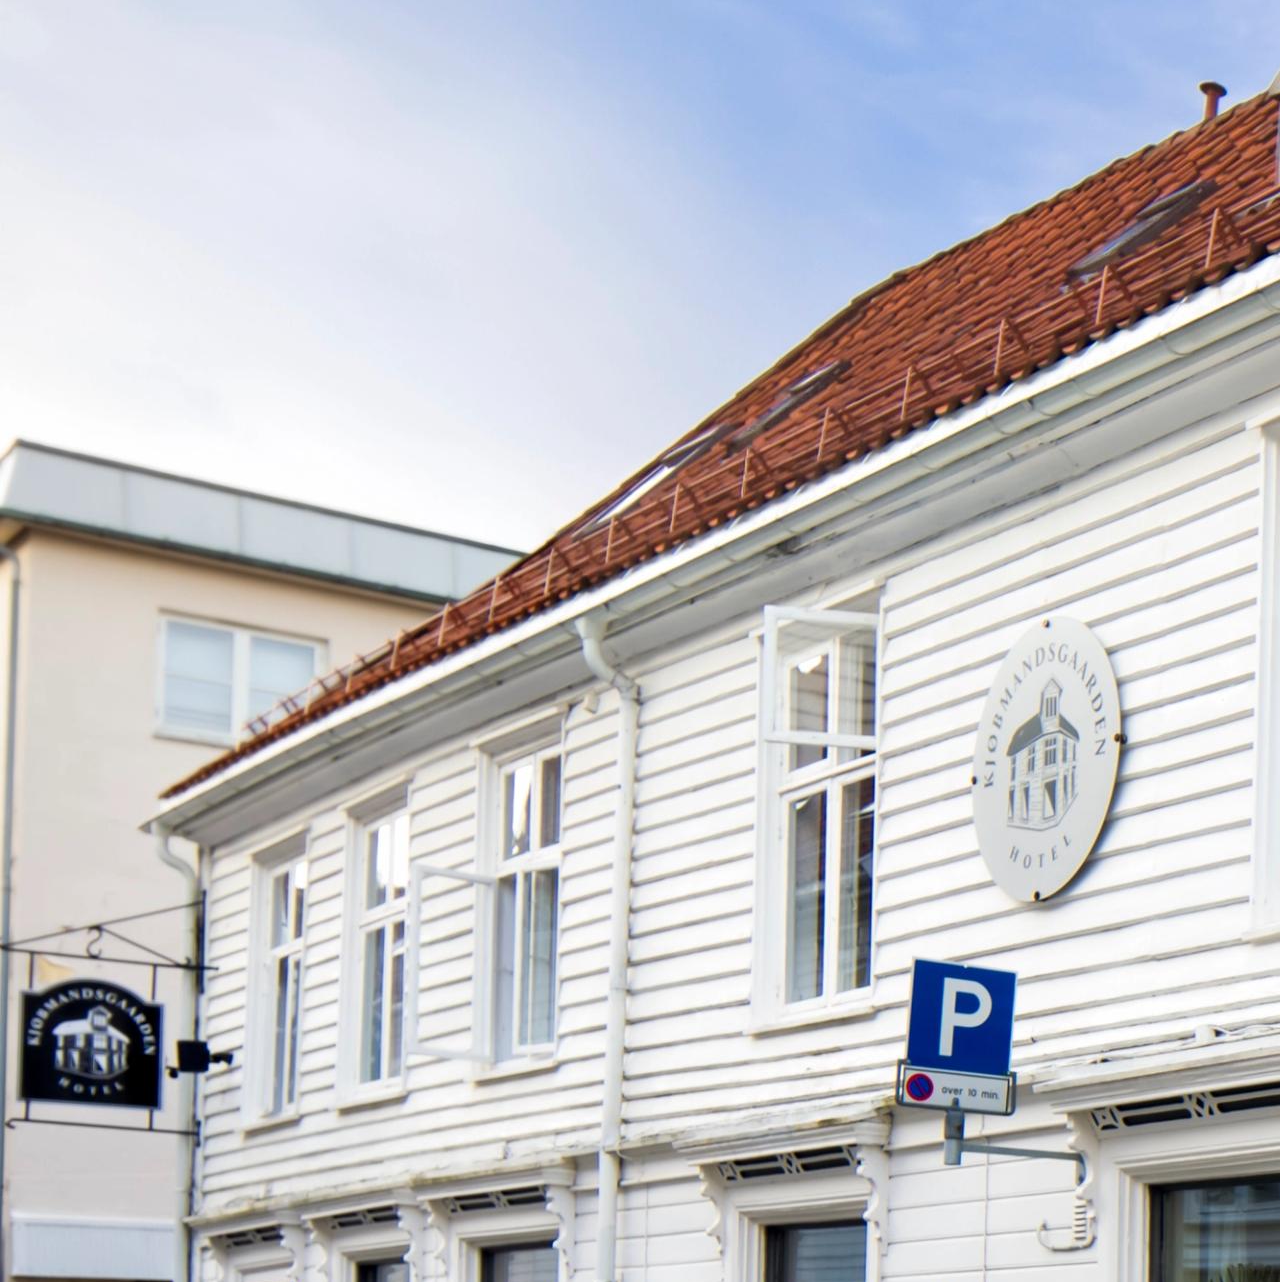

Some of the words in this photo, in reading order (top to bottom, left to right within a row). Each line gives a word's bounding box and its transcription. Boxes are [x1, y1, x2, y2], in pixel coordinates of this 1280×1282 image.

[1009, 834, 1071, 869] HOTEL
[939, 977, 992, 1056] P
[58, 1077, 124, 1095] HOTEL
[941, 1086, 963, 1096] over
[967, 1088, 977, 1097] 10
